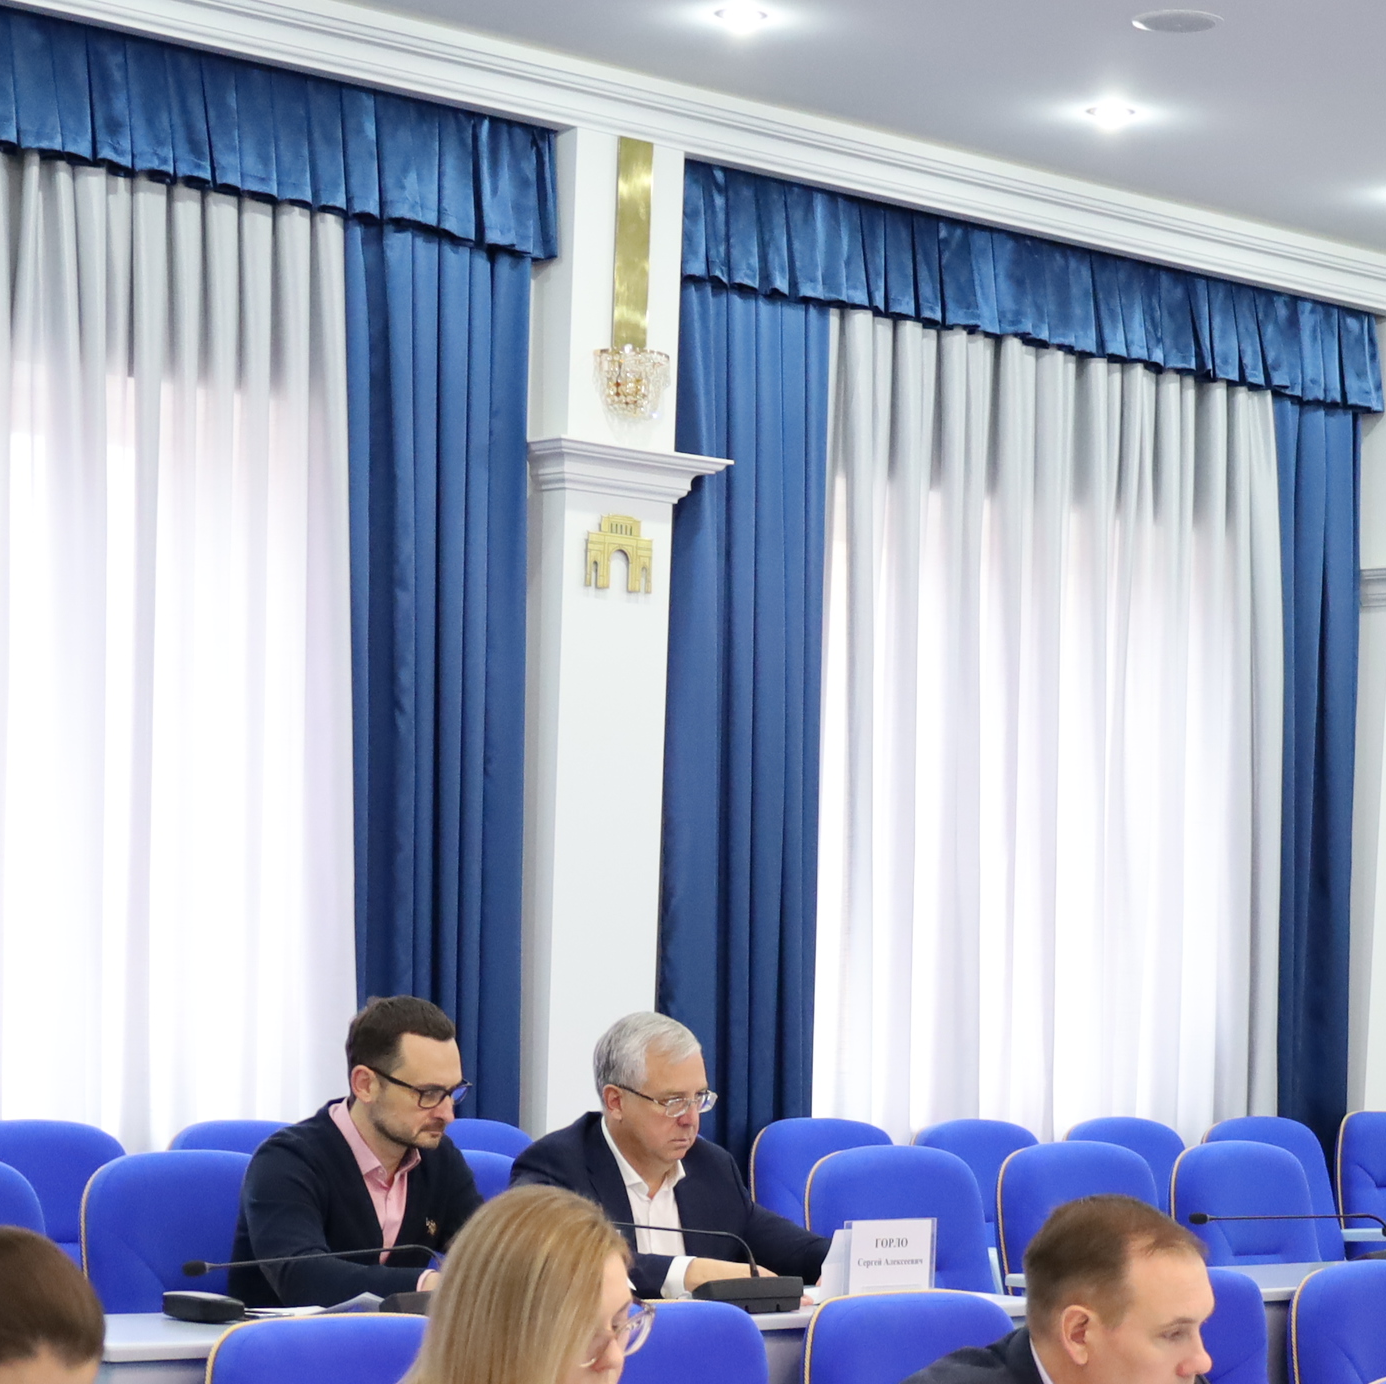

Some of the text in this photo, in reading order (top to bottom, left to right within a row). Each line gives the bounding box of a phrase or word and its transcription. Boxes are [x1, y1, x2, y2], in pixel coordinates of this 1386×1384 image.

[875, 1238, 908, 1248] ГОРЛО
[857, 1258, 923, 1268] Сергей Алексеевич
